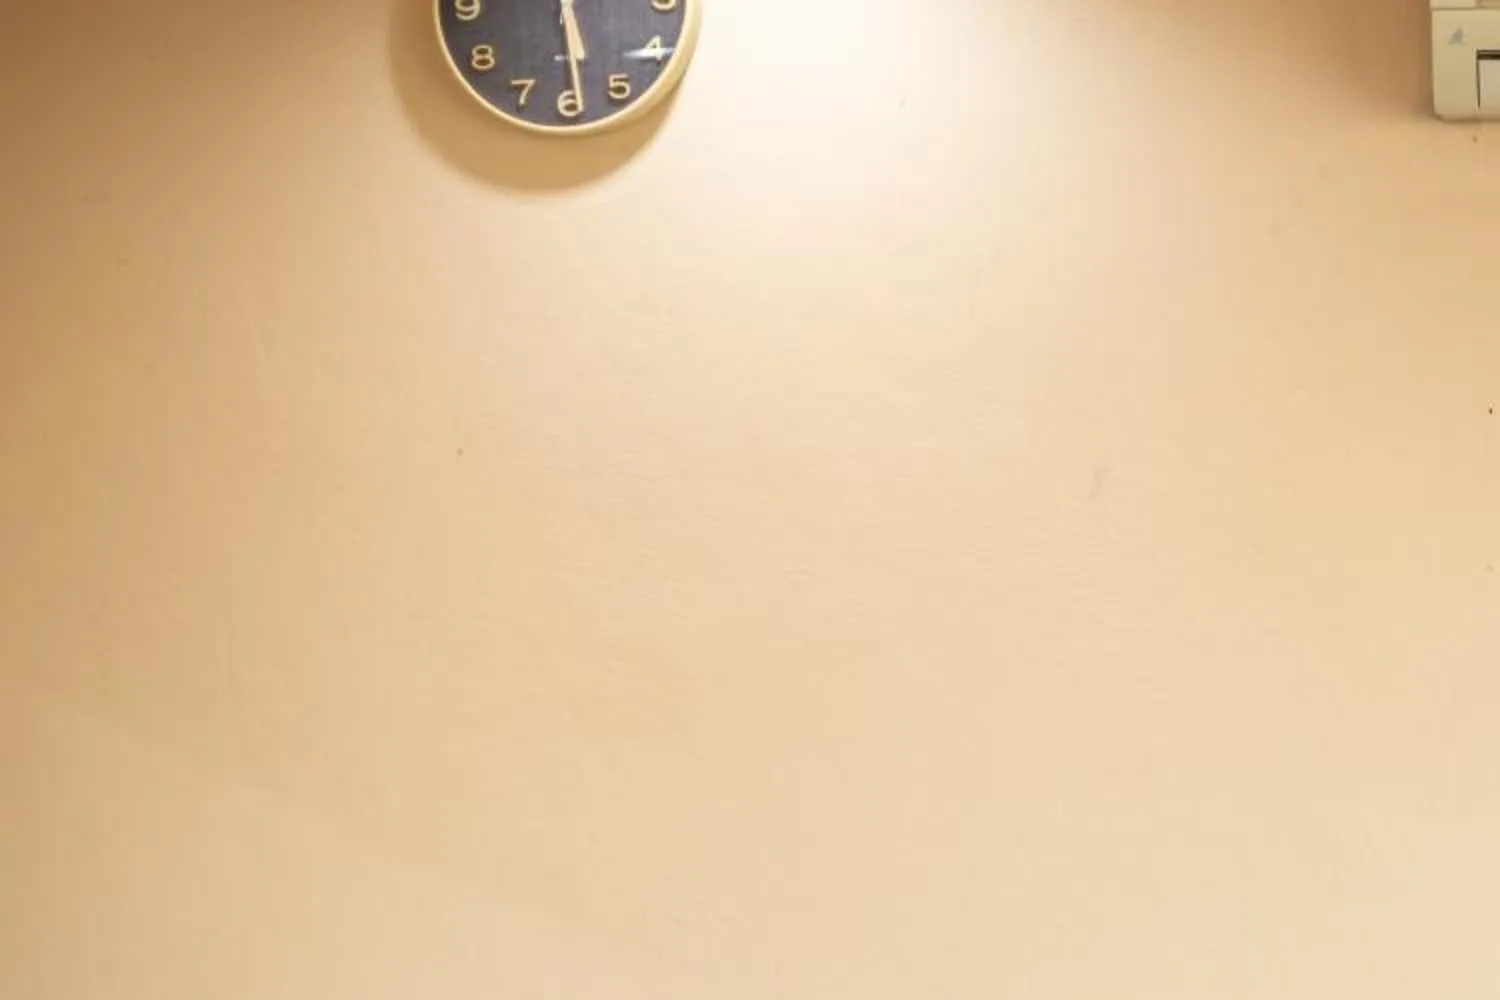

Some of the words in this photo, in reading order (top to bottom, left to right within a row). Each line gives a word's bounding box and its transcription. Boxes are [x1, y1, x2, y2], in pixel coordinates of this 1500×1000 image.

[471, 45, 496, 71] 8
[644, 35, 666, 61] 4
[511, 79, 536, 105] 7
[608, 74, 631, 99] 5
[557, 90, 583, 117] 6
